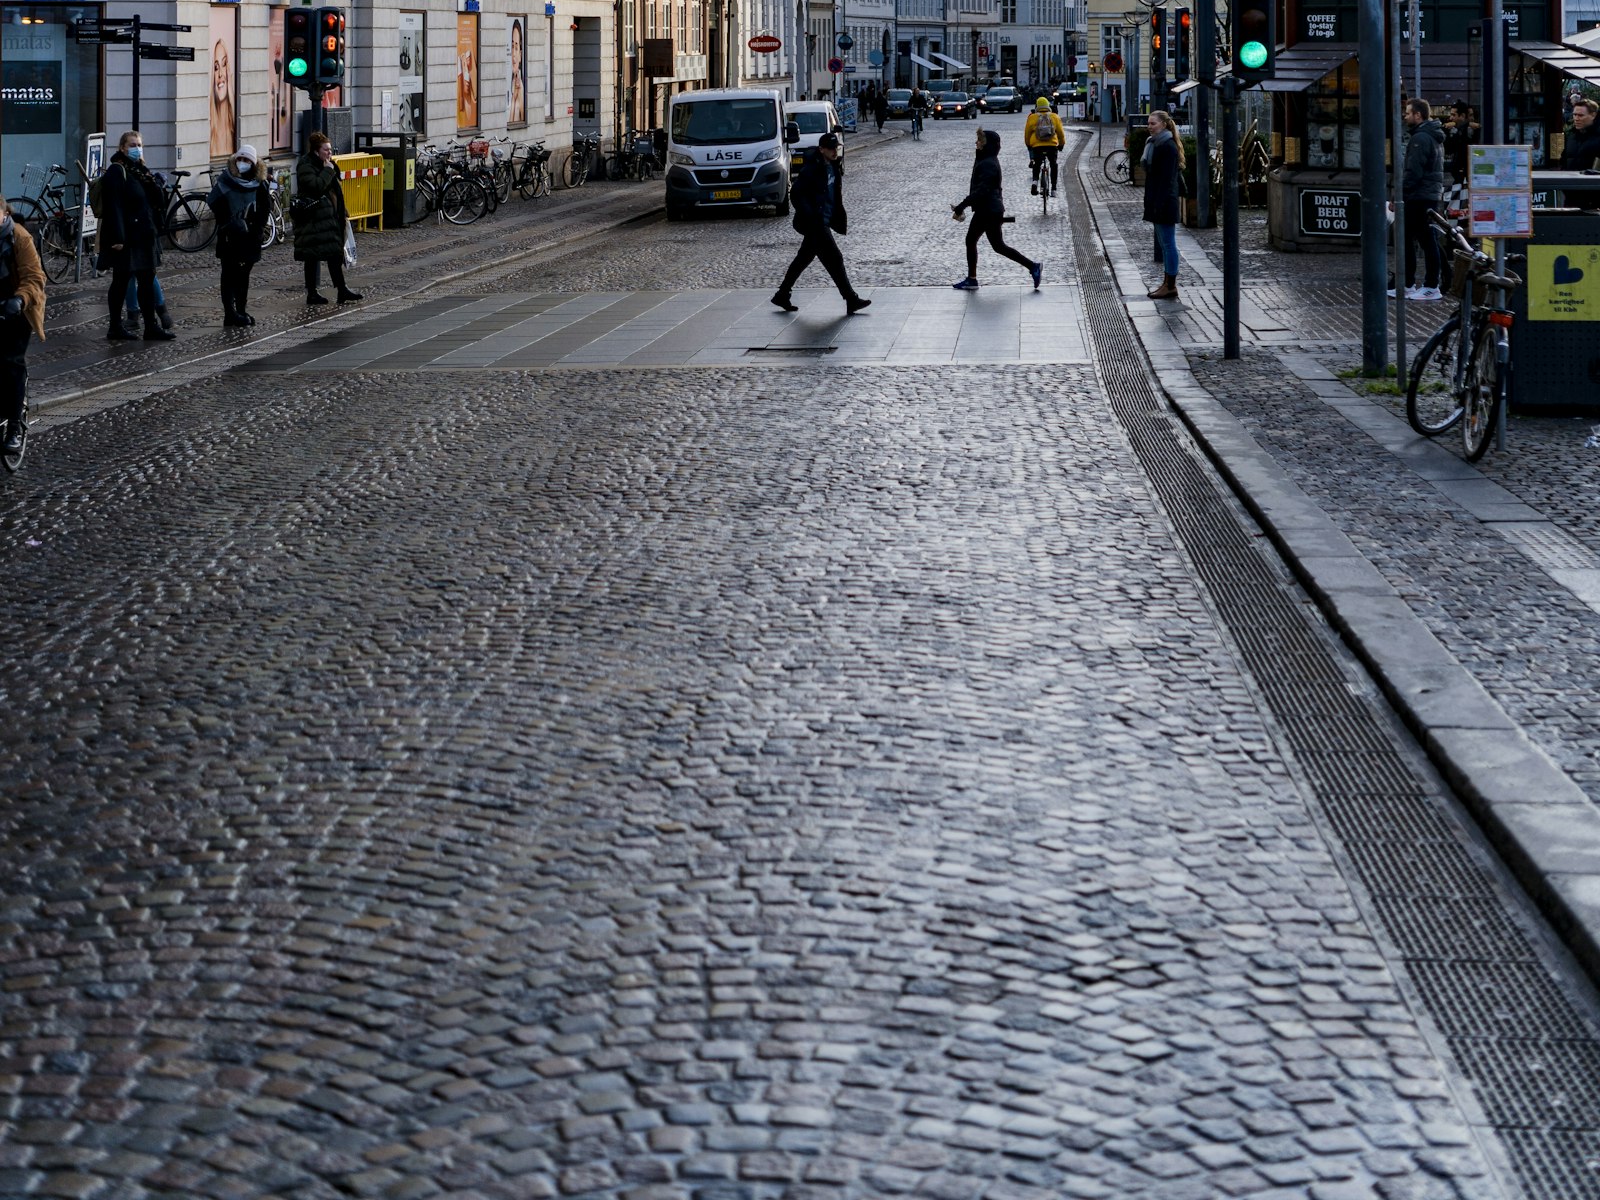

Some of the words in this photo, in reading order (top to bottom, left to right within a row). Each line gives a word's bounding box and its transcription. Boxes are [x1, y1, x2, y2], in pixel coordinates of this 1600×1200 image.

[1308, 29, 1315, 37] &
[1315, 30, 1335, 38] to-go
[1, 86, 54, 101] matas
[707, 150, 743, 161] LÄSE
[1314, 196, 1349, 206] DRAFT
[1318, 207, 1346, 217] BEER
[1316, 219, 1331, 228] TO
[1333, 220, 1348, 229] GO
